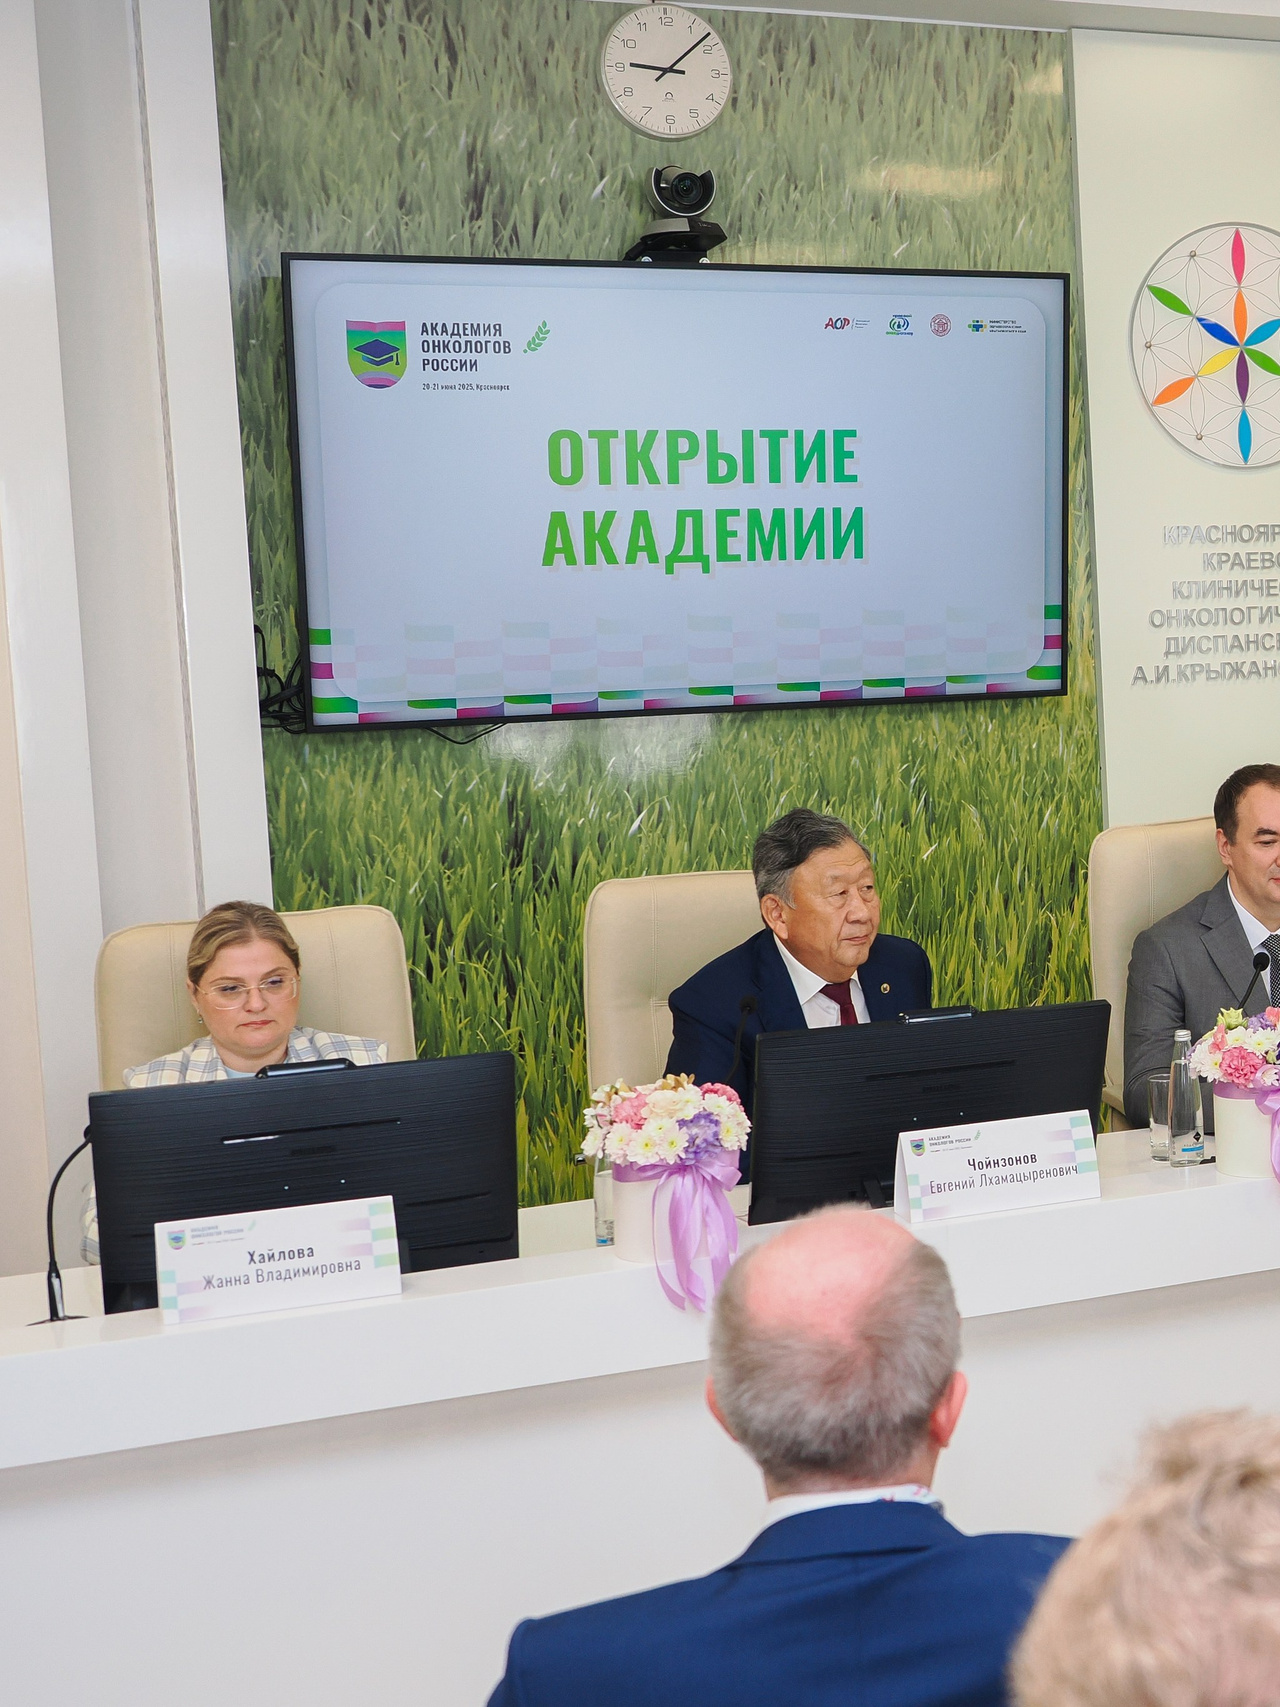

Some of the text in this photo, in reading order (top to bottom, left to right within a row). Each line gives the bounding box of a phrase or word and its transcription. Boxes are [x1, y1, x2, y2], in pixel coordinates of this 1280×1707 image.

[636, 21, 647, 32] 11
[658, 16, 674, 27] 12
[687, 25, 693, 35] 1
[620, 38, 637, 49] 10
[702, 44, 713, 55] 2
[614, 61, 626, 73] 9
[710, 69, 721, 79] 3
[623, 86, 634, 97] 8
[705, 93, 714, 101] 4
[641, 105, 653, 116] 7
[688, 108, 700, 119] 5
[665, 114, 676, 125] 6
[420, 322, 502, 339] АКАДЕМИЯ
[421, 340, 512, 354] ОНКОЛОГОВ
[422, 358, 478, 372] РОССИИ
[422, 382, 439, 390] 20-21
[458, 382, 475, 391] 2025,
[476, 384, 510, 392] Красноярск
[547, 429, 859, 487] ОТКРЫТИЕ
[541, 506, 864, 576] АКАДЕМИИ
[967, 1152, 1038, 1172] Чойнзонов
[929, 1164, 1078, 1195] Евгений Лхамацыренович
[247, 1246, 315, 1266] Хайлова
[202, 1258, 362, 1291] Жанна Владимировна
